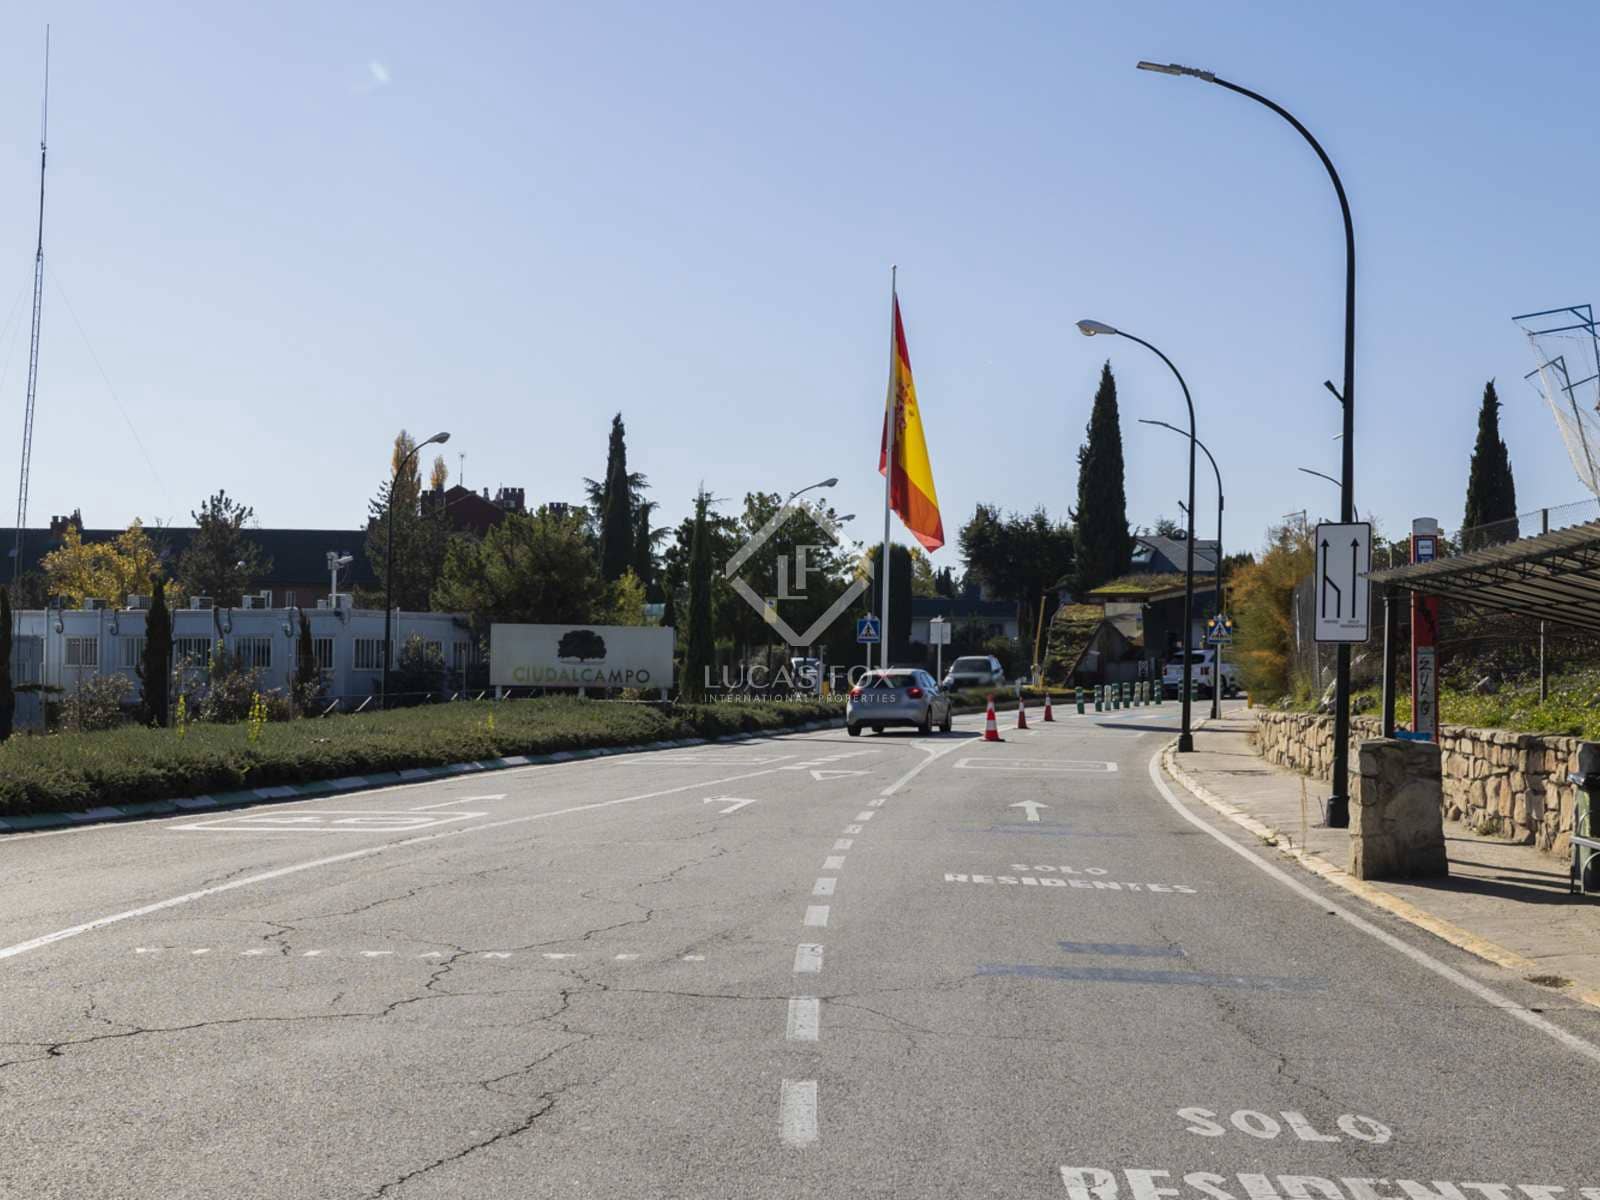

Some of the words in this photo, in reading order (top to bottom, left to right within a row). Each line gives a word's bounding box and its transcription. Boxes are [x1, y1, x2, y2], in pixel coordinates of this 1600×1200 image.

[512, 666, 650, 684] CIUDALCAMPO
[1010, 863, 1108, 875] SOLO
[943, 873, 1198, 894] RESIDENTES
[1176, 1106, 1393, 1145] SOLO
[1060, 1165, 1600, 1200] RESIDEN
